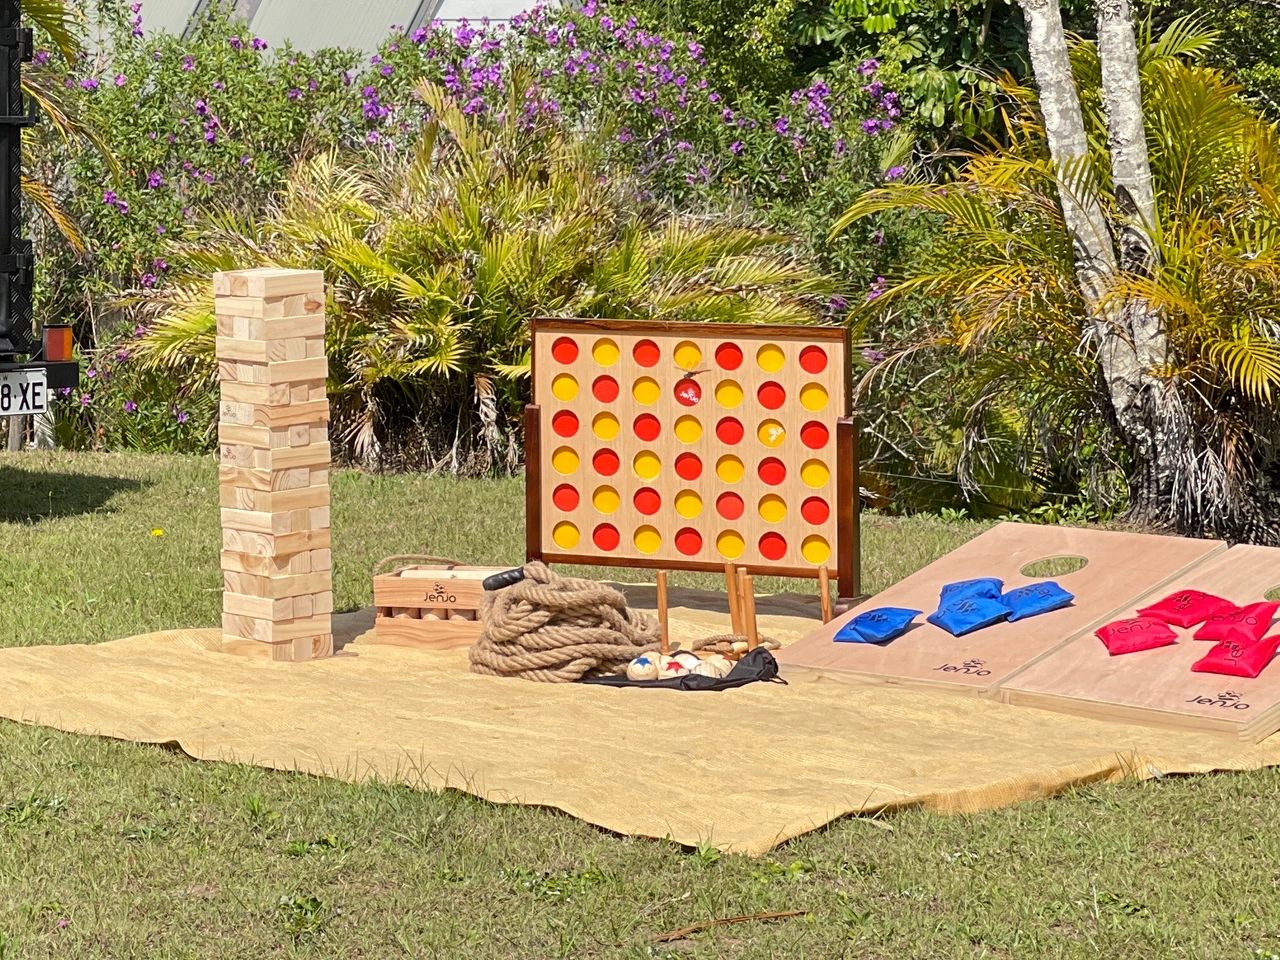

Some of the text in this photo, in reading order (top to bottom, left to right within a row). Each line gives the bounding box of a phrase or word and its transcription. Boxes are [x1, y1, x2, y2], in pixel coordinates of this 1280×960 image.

[423, 591, 457, 603] Jenjo
[932, 663, 992, 677] Jenjo
[1185, 695, 1250, 710] Jenjo
